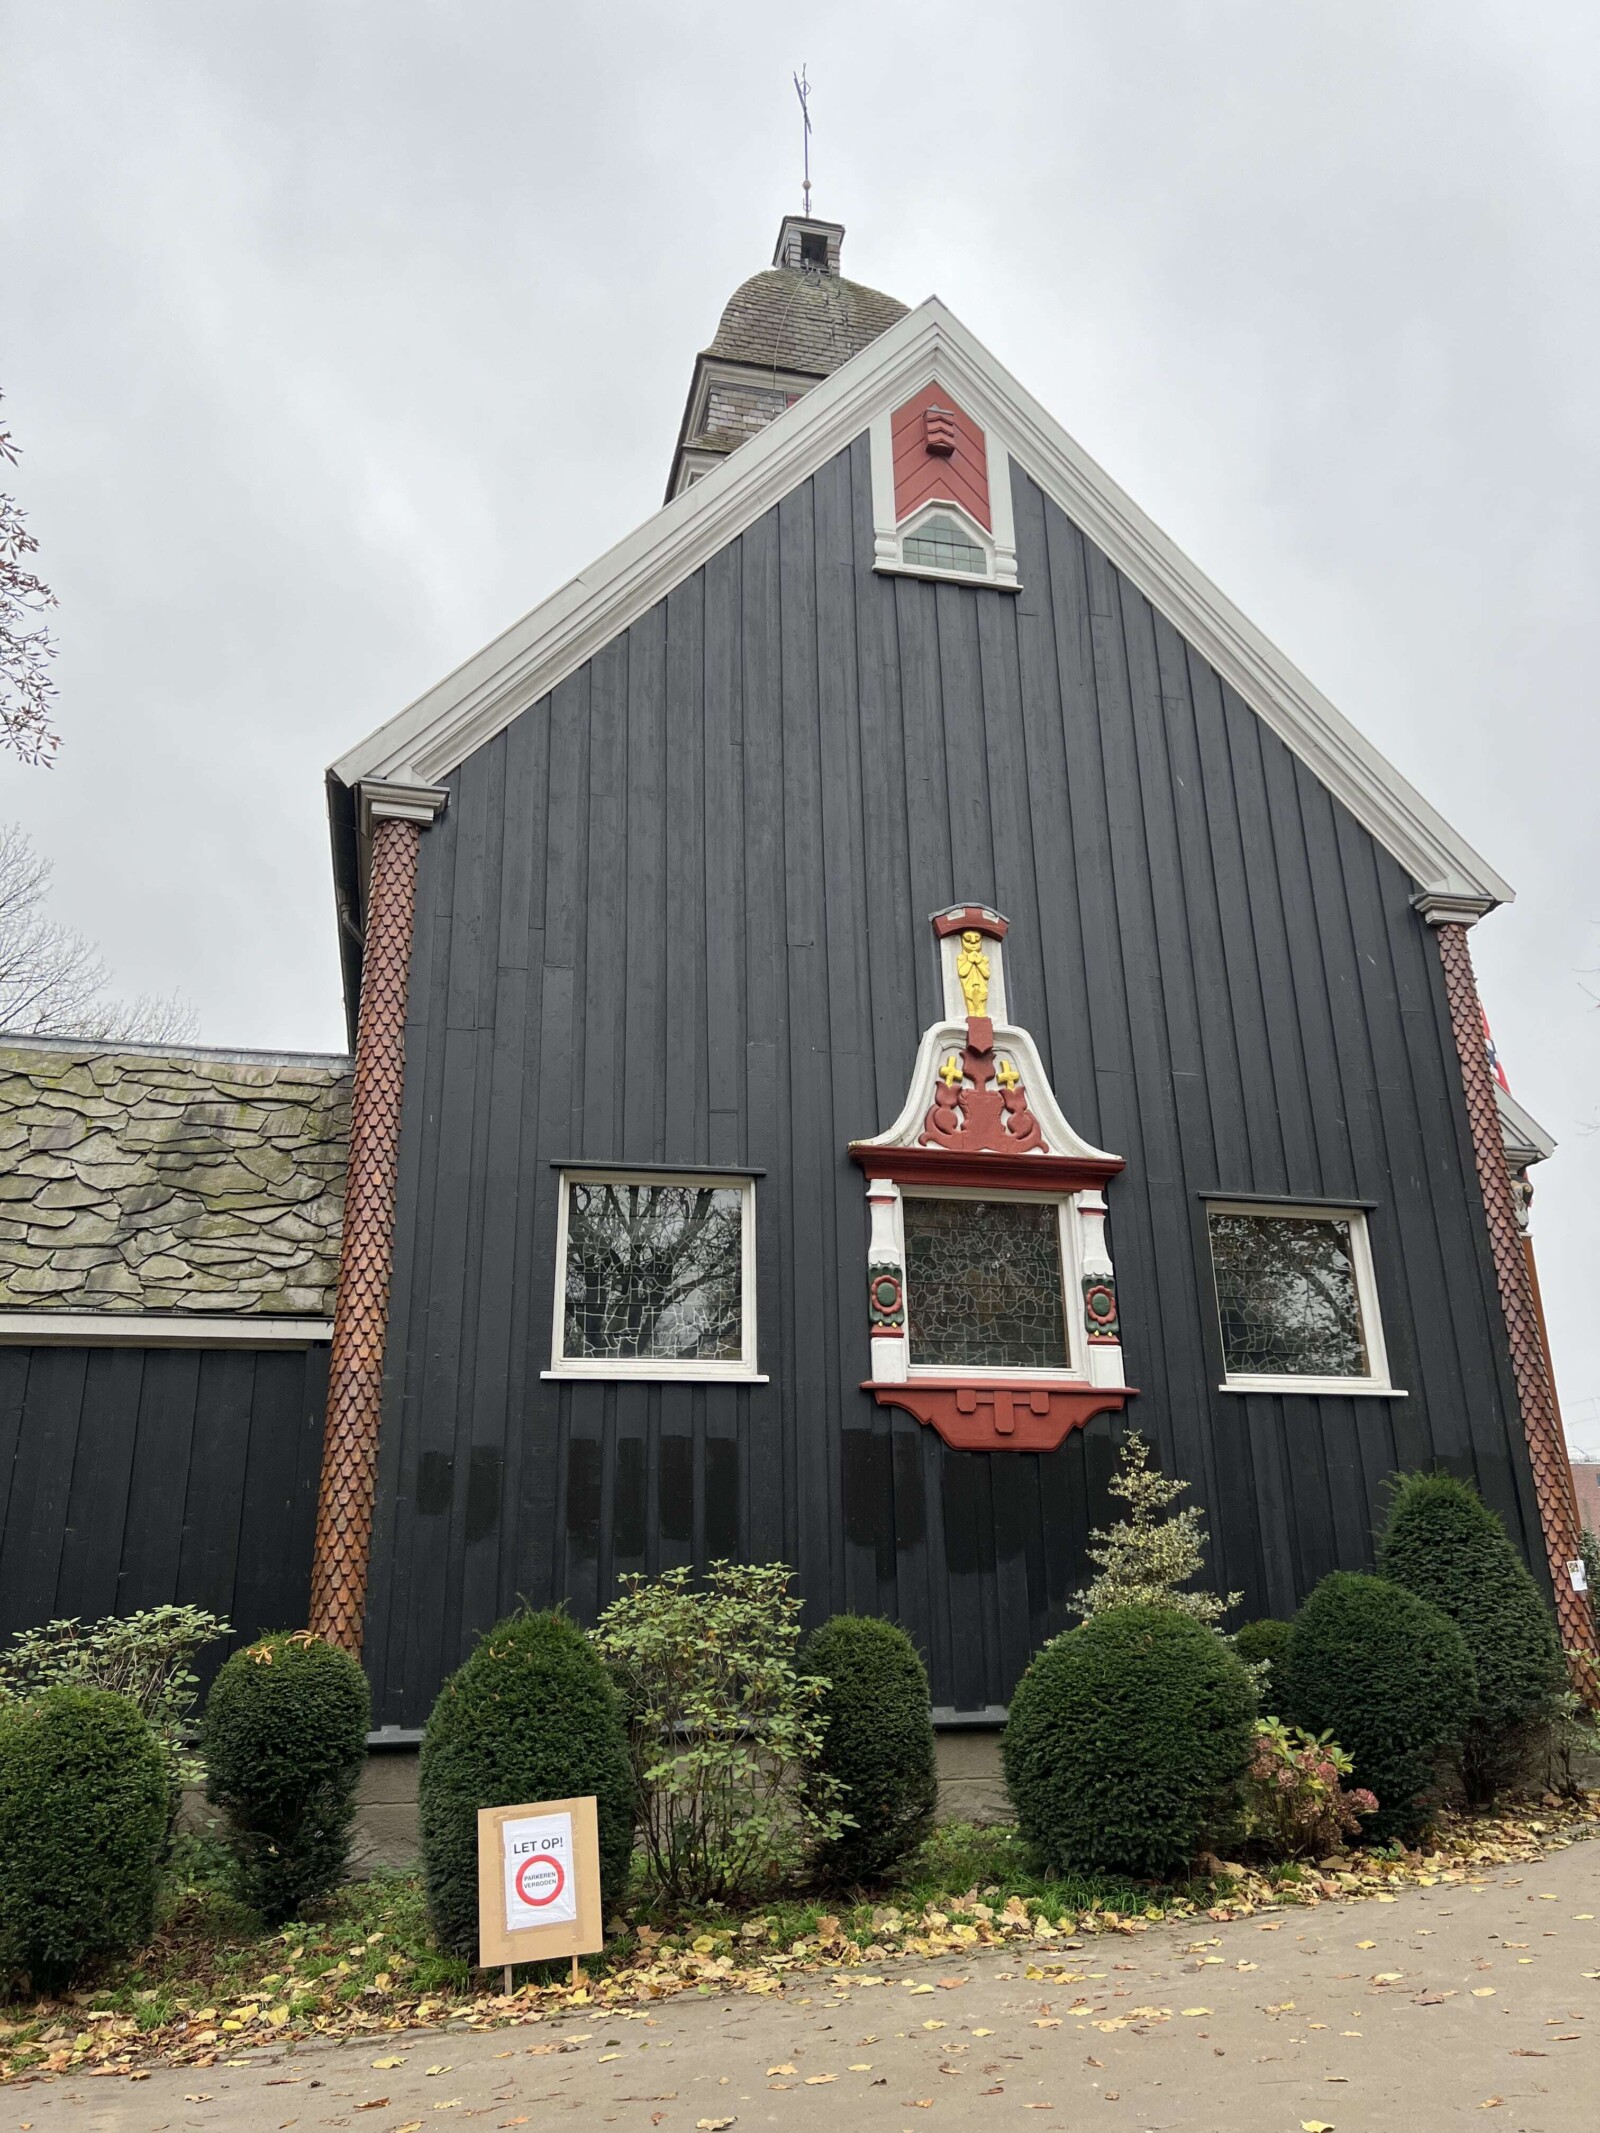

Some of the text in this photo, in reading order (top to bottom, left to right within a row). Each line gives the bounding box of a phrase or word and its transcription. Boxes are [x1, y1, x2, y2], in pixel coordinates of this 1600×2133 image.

[513, 1837, 563, 1854] LET OP!
[524, 1872, 556, 1881] PARKEREN
[524, 1879, 557, 1889] VERBODEN
